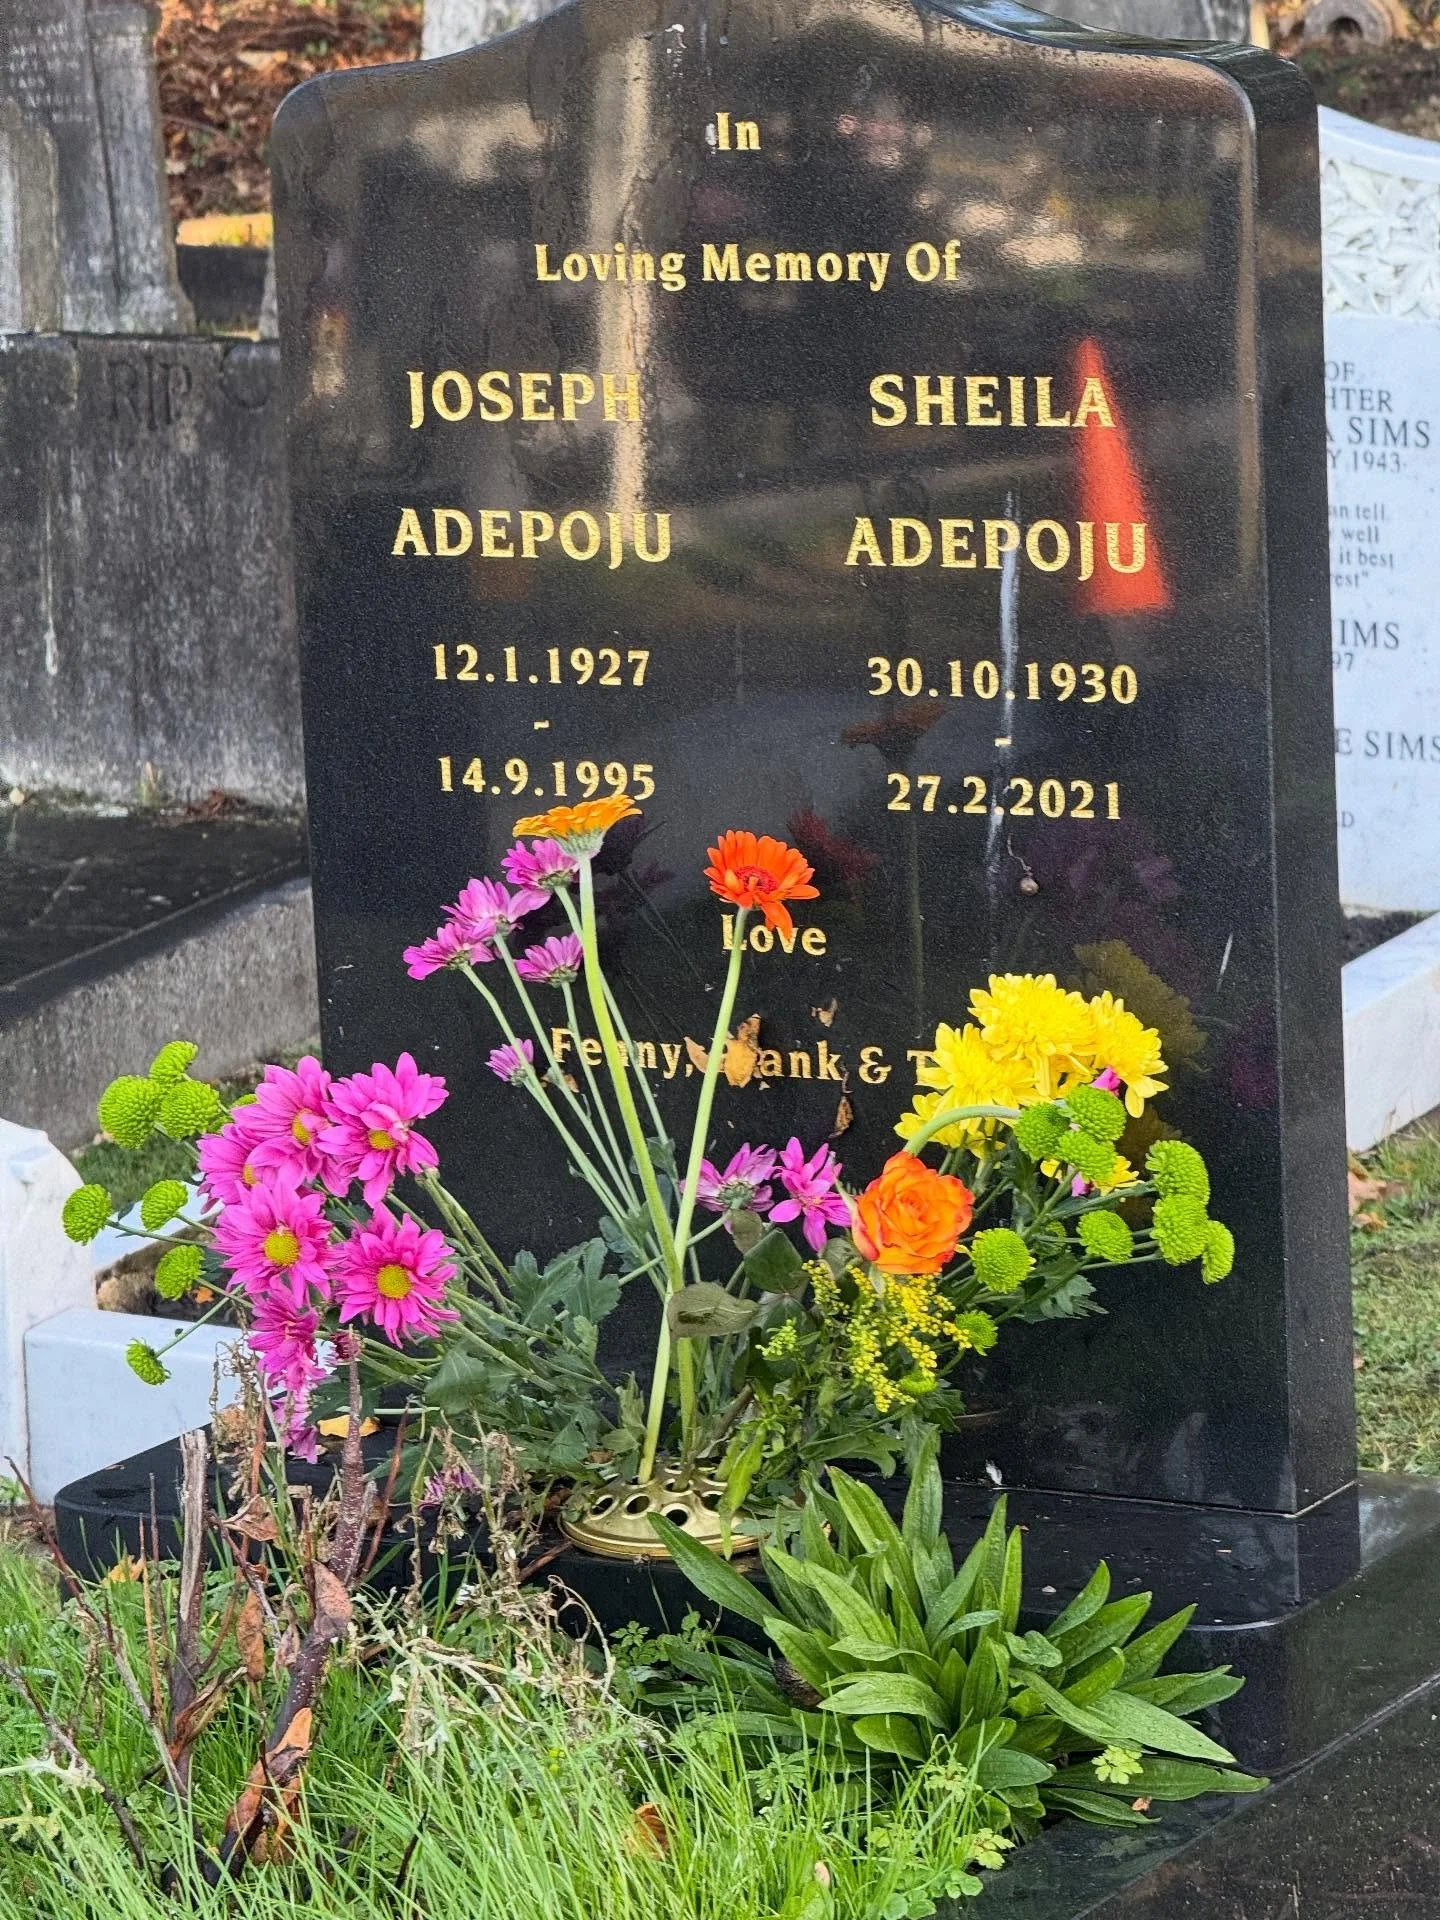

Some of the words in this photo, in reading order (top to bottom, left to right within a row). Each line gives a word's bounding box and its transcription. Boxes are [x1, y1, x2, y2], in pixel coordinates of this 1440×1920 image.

[715, 112, 761, 150] In
[535, 243, 686, 291] Loving
[702, 243, 891, 292] Memory
[905, 240, 961, 282] Of
[406, 371, 643, 429] JOSEPH
[869, 373, 1116, 428] SHEILA
[1347, 416, 1431, 449] SIMS
[391, 507, 672, 569] ADEPOJU
[844, 516, 1148, 581] ADEPOJU
[1338, 618, 1400, 650] IMS
[432, 643, 649, 686] 12.1.1927
[867, 656, 1138, 705] 30.10.1930
[438, 755, 655, 800] 14.9.1995
[887, 772, 1120, 820] 27.2.2021
[858, 1045, 892, 1084] &
